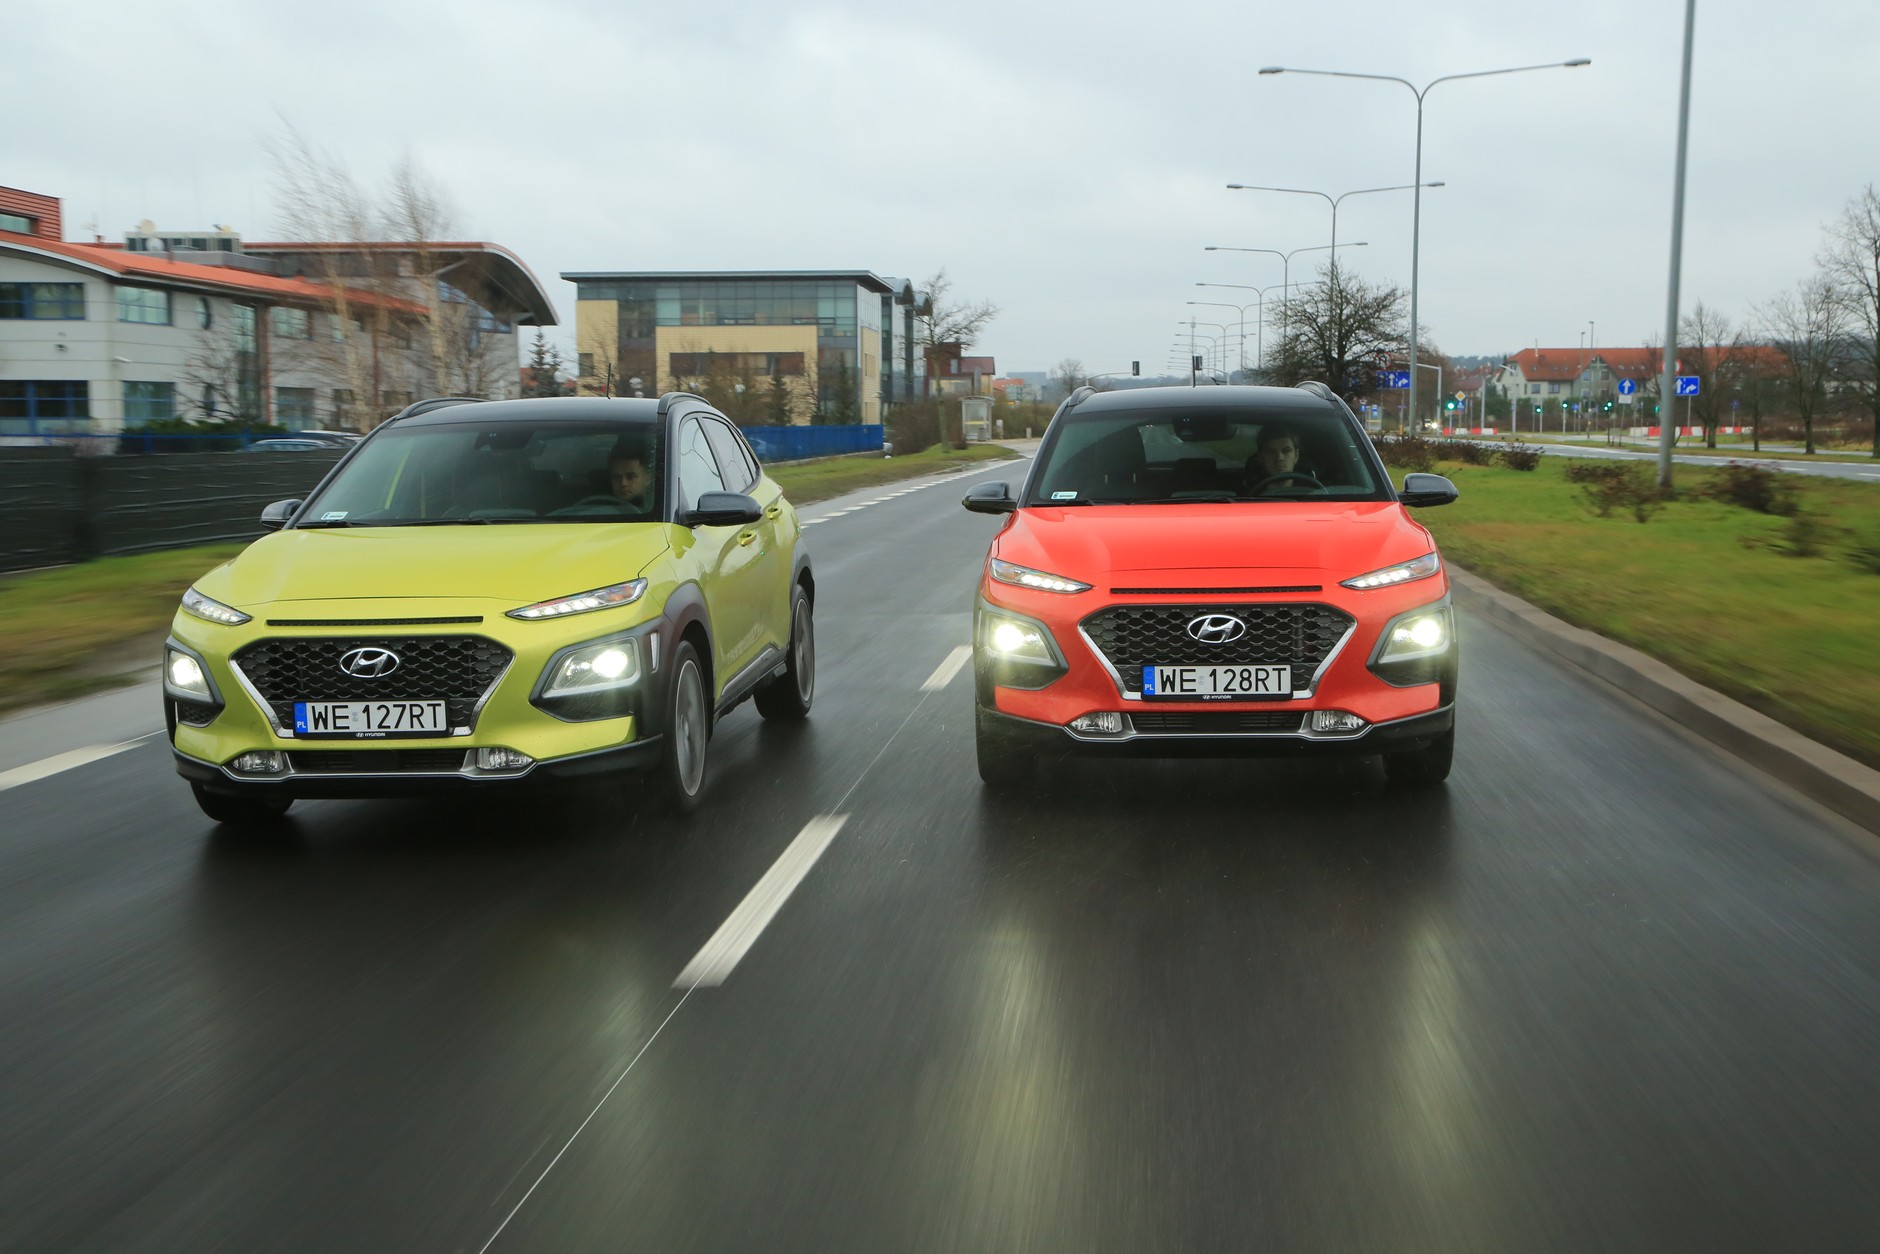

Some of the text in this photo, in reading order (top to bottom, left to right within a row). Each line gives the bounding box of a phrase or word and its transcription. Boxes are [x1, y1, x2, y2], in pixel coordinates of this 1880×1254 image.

[1159, 667, 1287, 692] WE 128RT
[297, 721, 307, 729] PL
[311, 703, 442, 730] WE 127RT
